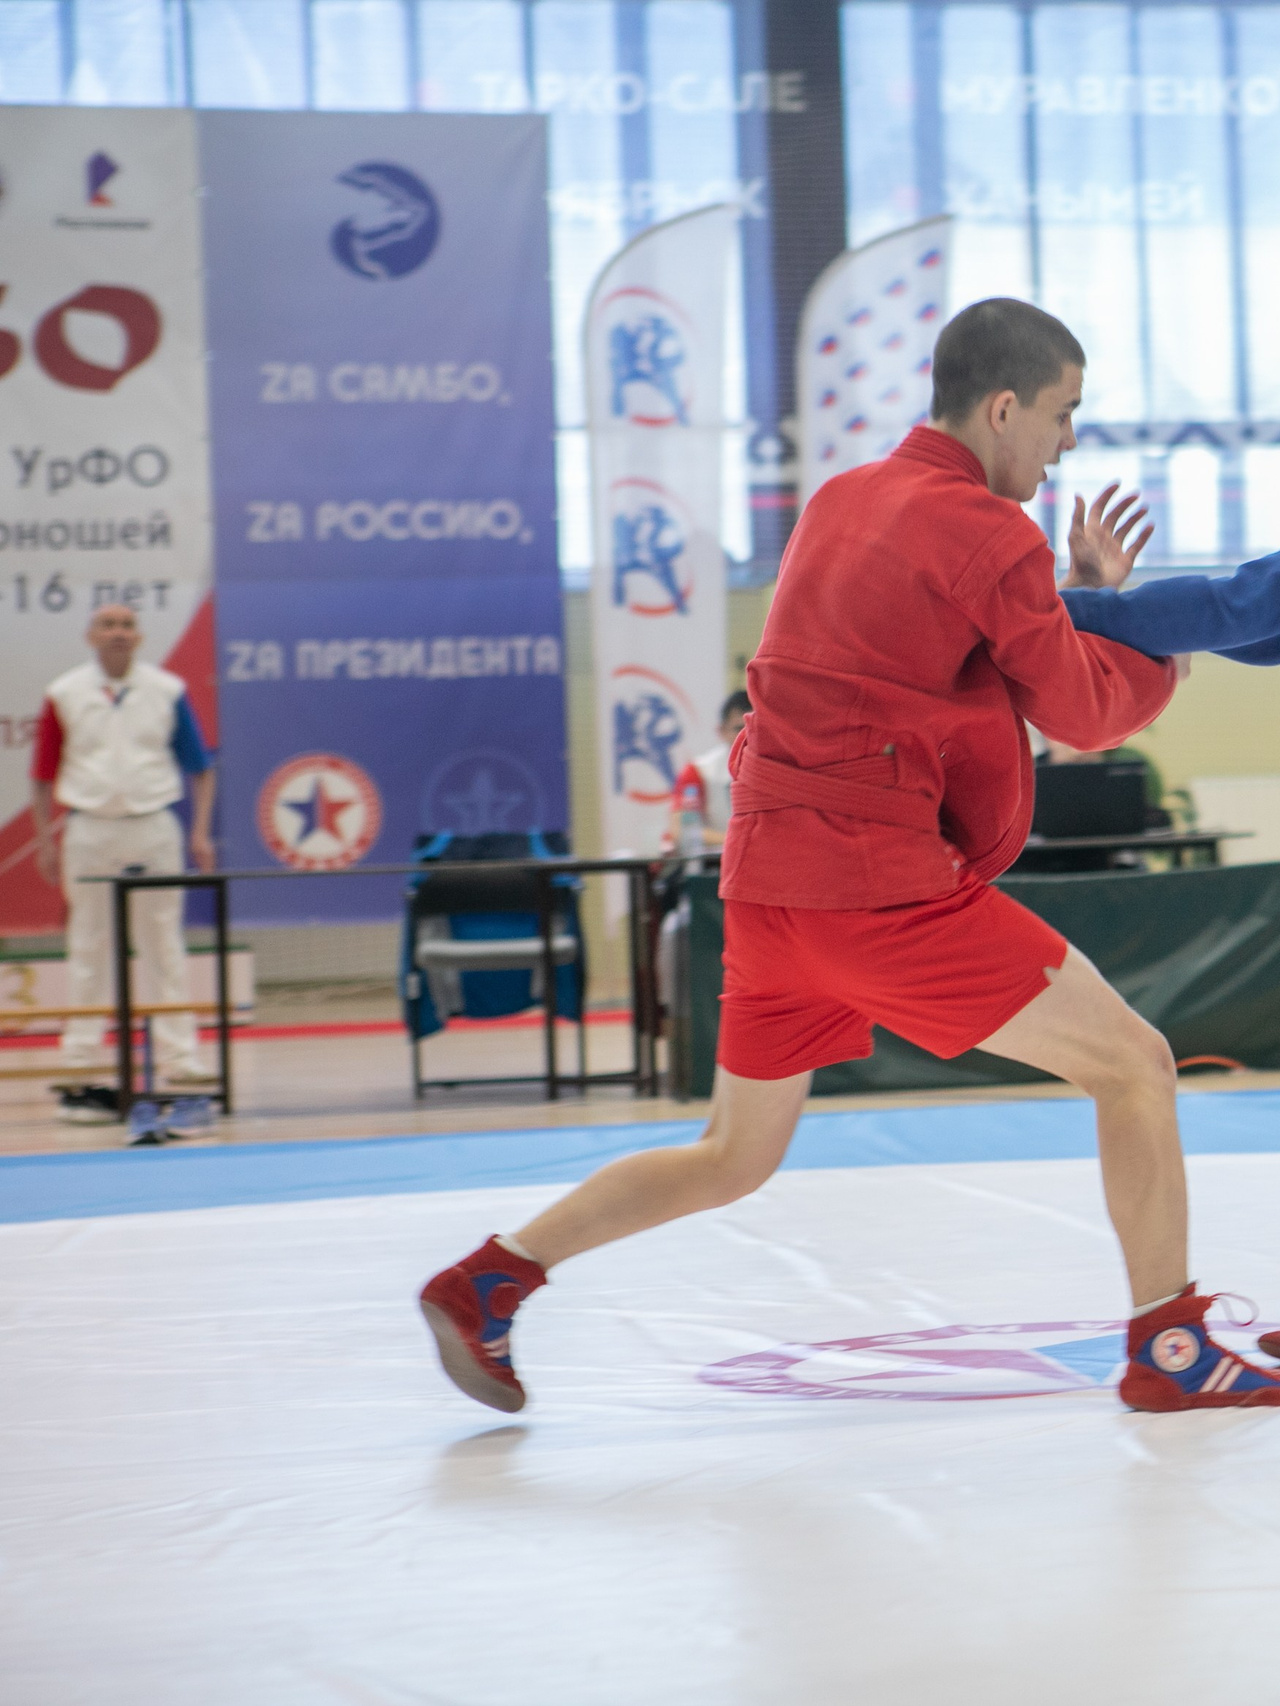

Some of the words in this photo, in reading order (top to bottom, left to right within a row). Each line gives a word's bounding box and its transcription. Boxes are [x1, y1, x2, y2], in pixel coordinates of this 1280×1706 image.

[474, 72, 806, 112] ТАРКО-САЛЕ
[13, 443, 170, 495] УрФО
[296, 635, 560, 680] ПРЕЗИДЕНТА
